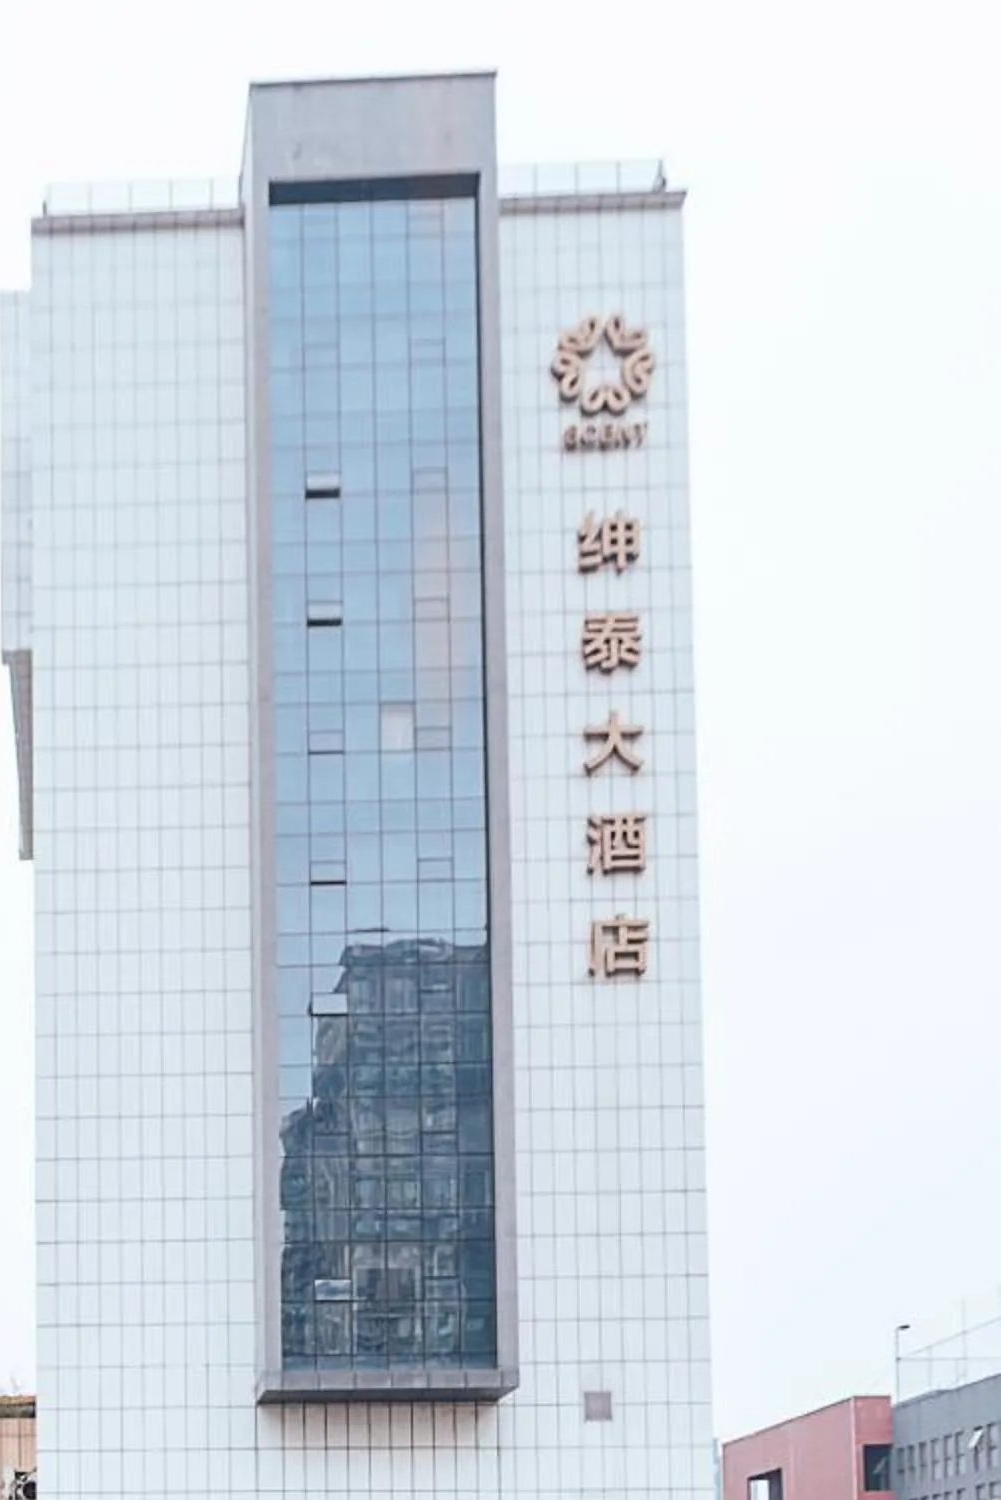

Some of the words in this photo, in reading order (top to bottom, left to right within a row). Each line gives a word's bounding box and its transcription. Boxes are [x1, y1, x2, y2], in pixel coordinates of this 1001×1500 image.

[576, 510, 649, 979] 绅泰大酒店
